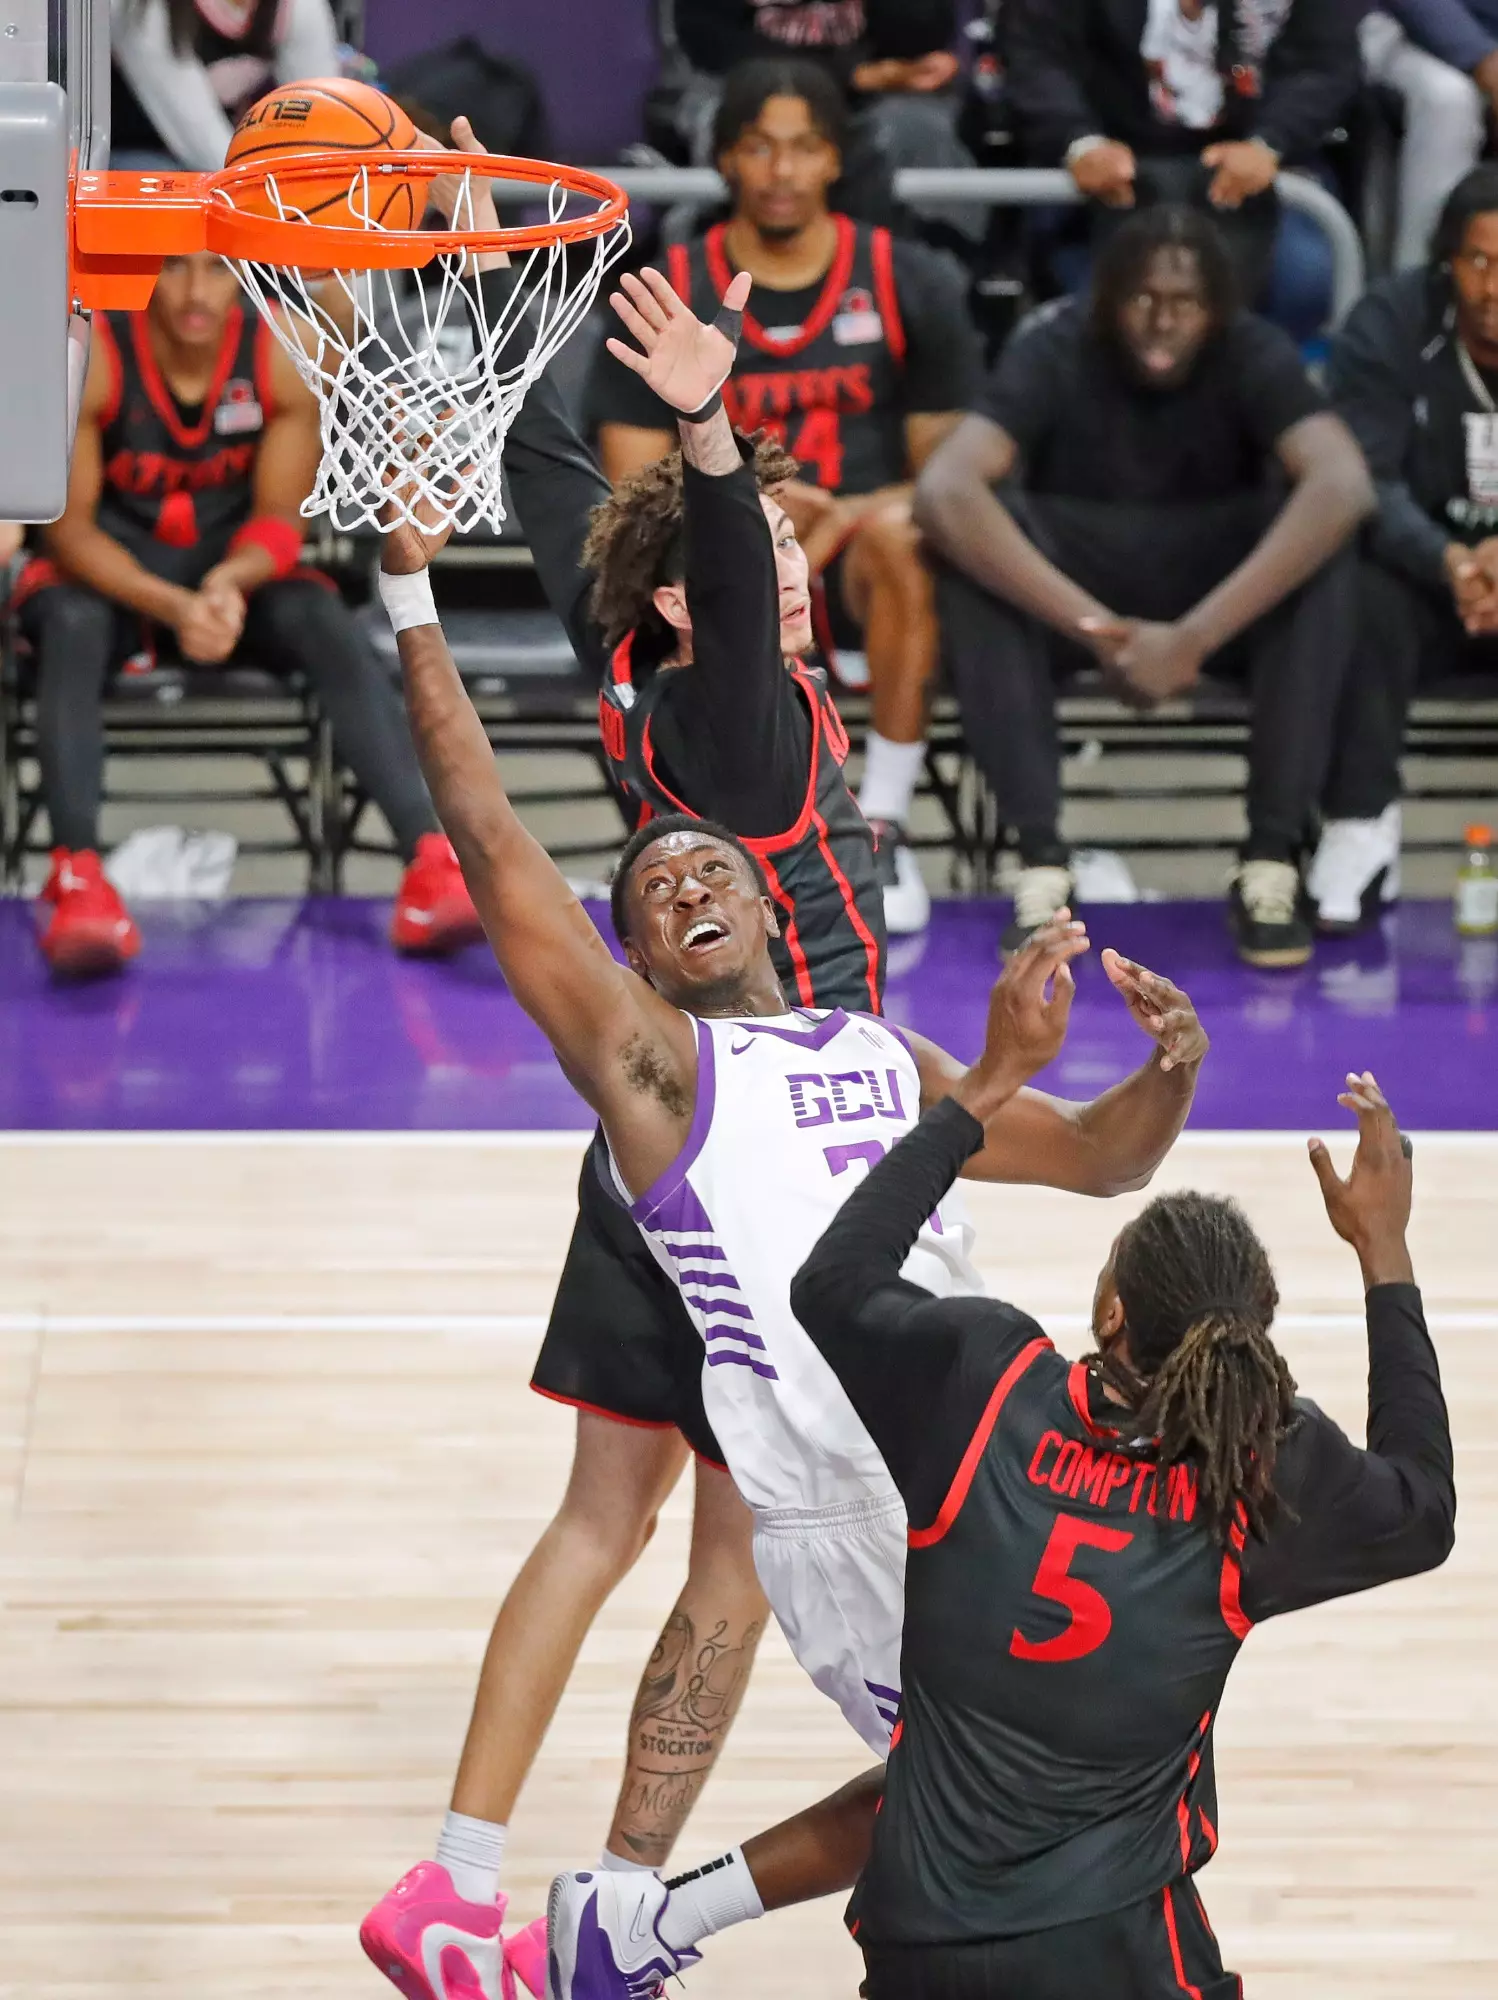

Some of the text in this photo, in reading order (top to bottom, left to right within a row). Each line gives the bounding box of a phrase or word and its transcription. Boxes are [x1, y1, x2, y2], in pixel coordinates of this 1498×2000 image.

[784, 1068, 907, 1129] GCU
[1009, 1512, 1136, 1663] 5
[639, 1734, 713, 1756] STOCKTON
